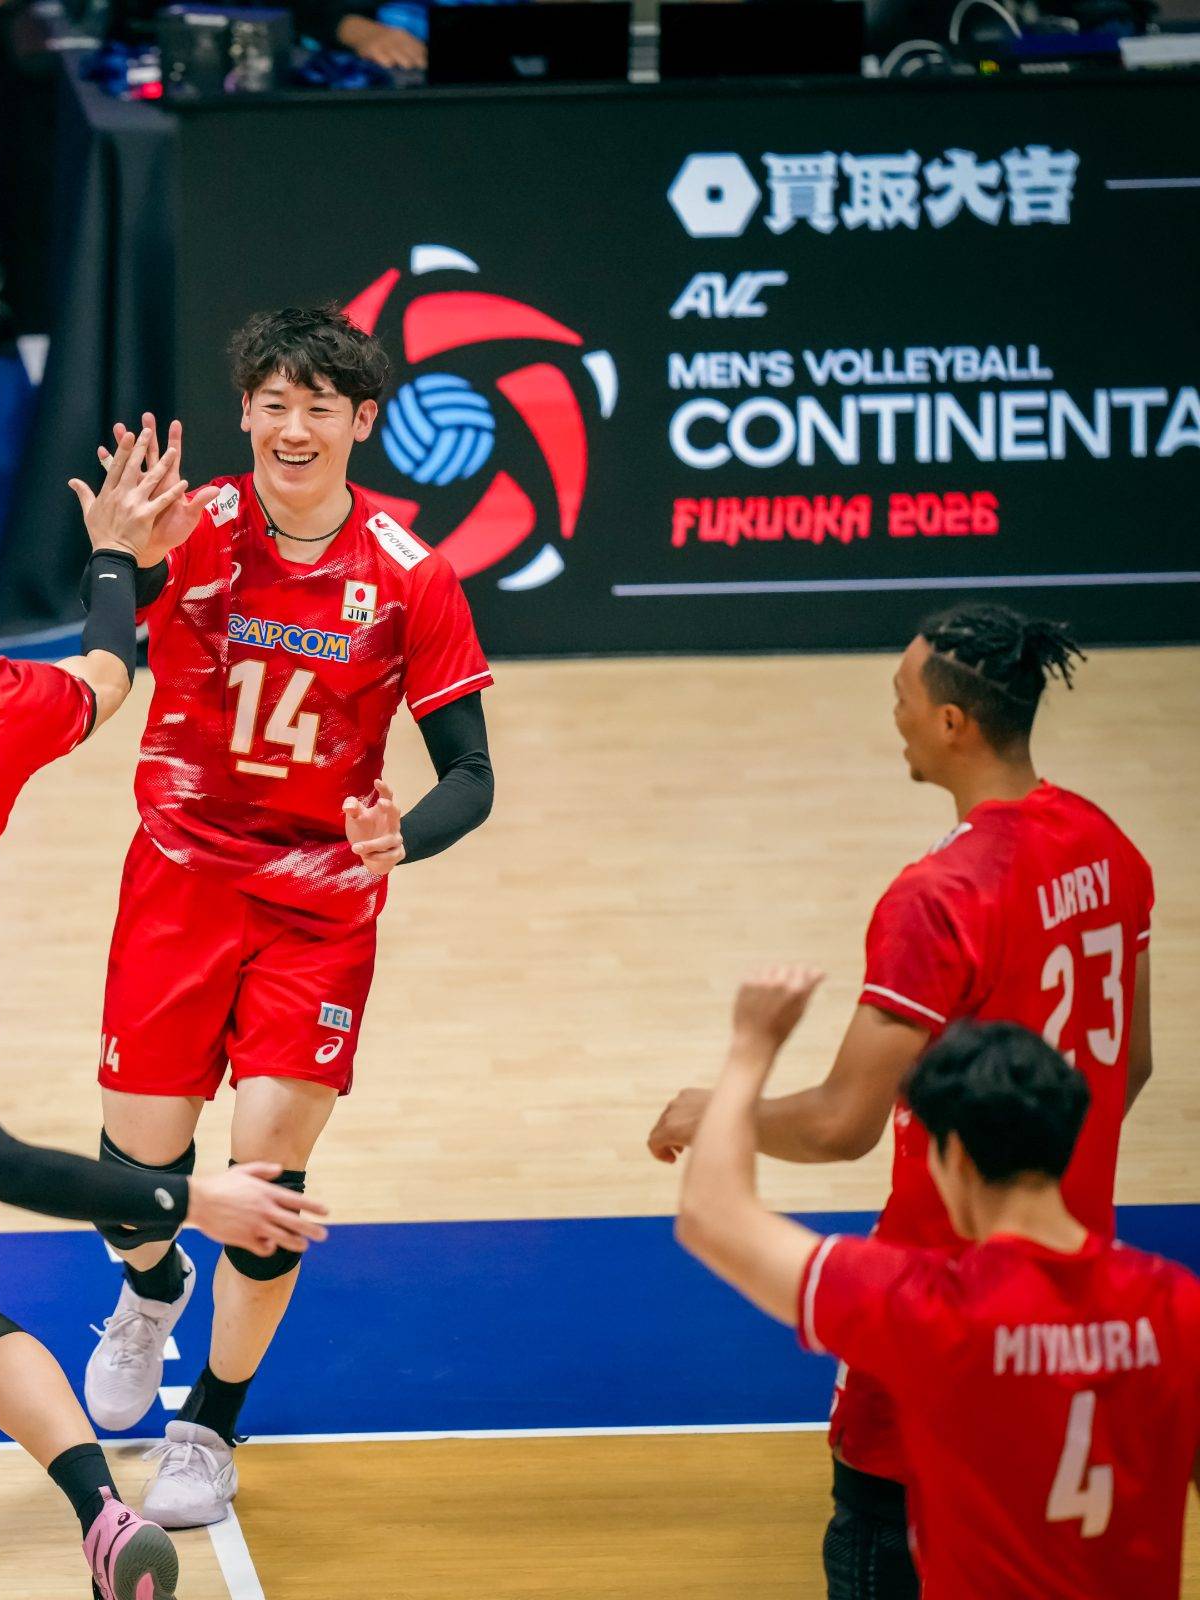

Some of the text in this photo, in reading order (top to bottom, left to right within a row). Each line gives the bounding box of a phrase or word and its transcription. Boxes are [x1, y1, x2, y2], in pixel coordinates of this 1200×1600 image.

[762, 145, 1080, 235] 買取大吉
[669, 271, 789, 319] AVC
[668, 345, 1053, 389] MEN'S VOLLEYBALL
[668, 387, 1200, 469] CONTINENTA
[671, 491, 999, 547] FUKUOKA 2026
[228, 613, 351, 663] CAPCOM
[348, 608, 368, 621] JIN
[227, 658, 321, 765] 14
[1037, 858, 1110, 931] LARRY
[322, 1006, 350, 1029] TEL
[1040, 921, 1124, 1070] 23
[993, 1316, 1160, 1376] MIYAURA
[1045, 1389, 1114, 1538] 4
